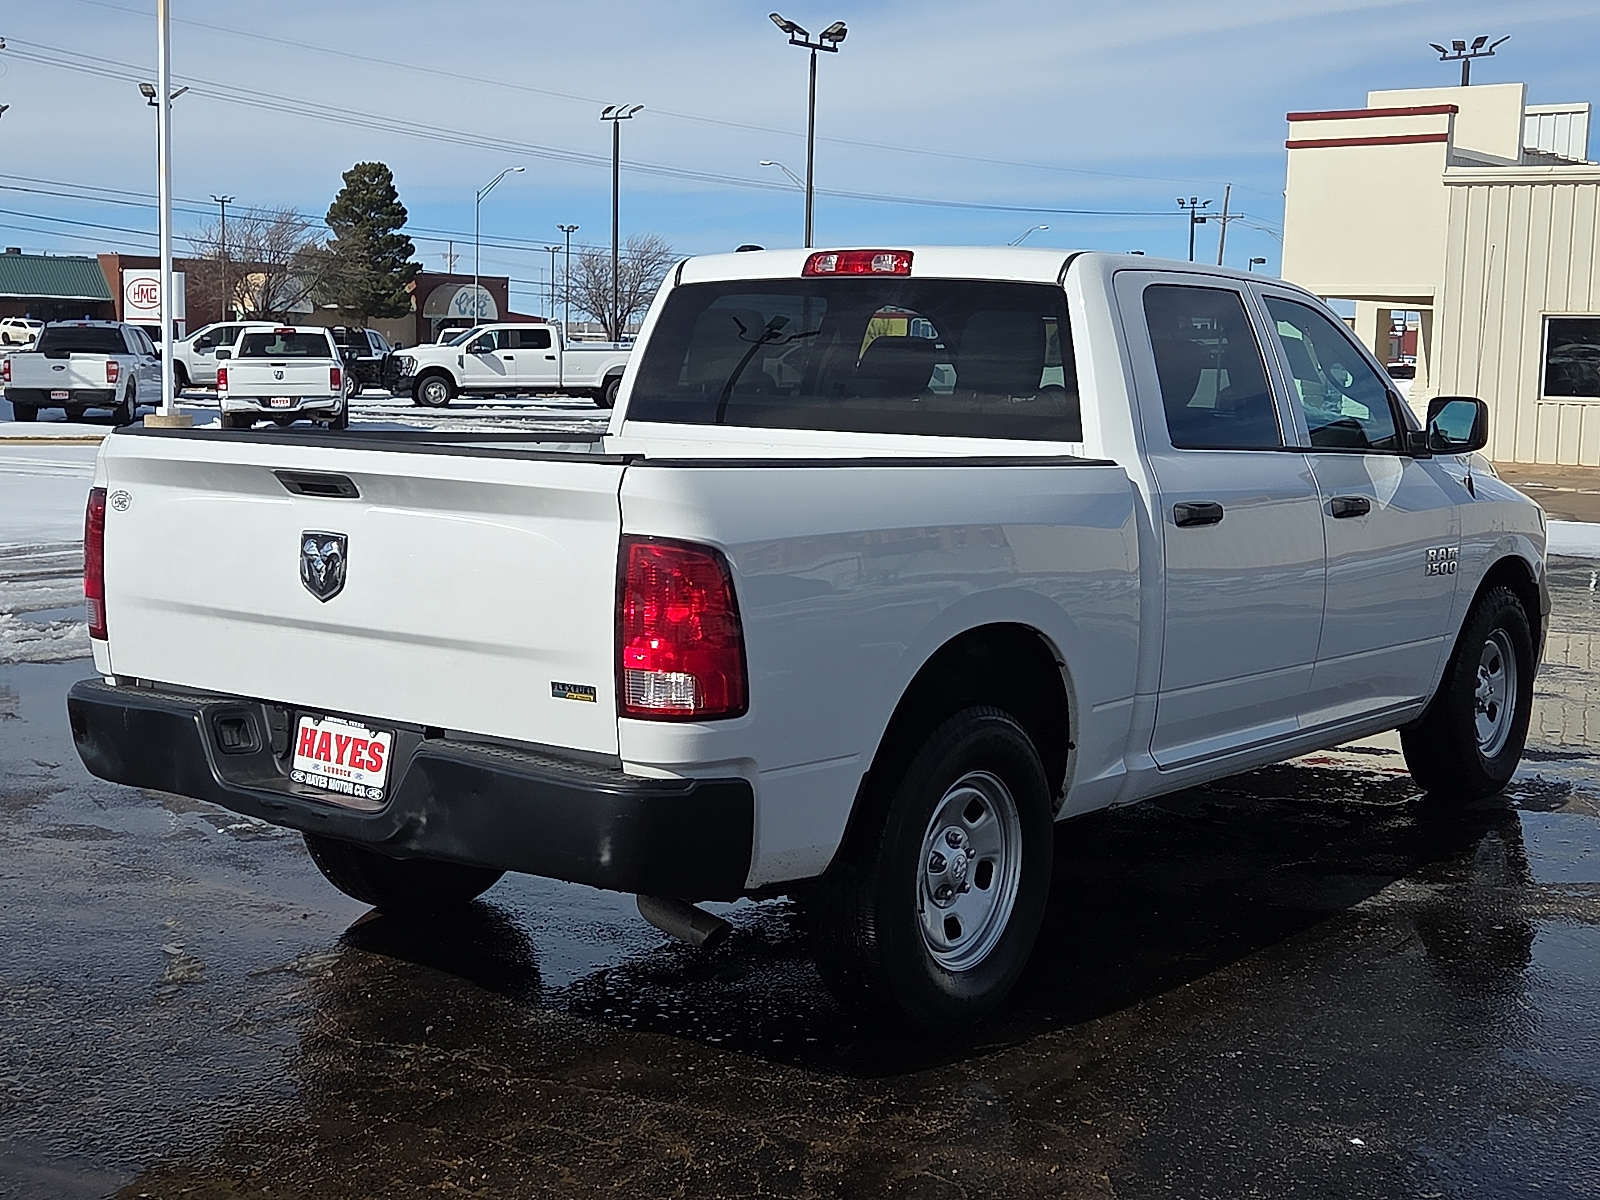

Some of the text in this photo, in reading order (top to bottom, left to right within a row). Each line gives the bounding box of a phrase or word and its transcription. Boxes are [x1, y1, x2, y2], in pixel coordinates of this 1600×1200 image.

[133, 284, 157, 303] HMC
[1427, 547, 1459, 561] RAM
[1426, 561, 1458, 575] 1500
[298, 726, 385, 772] HAYES
[305, 773, 328, 788] HAYES
[328, 777, 354, 795] MOTOR
